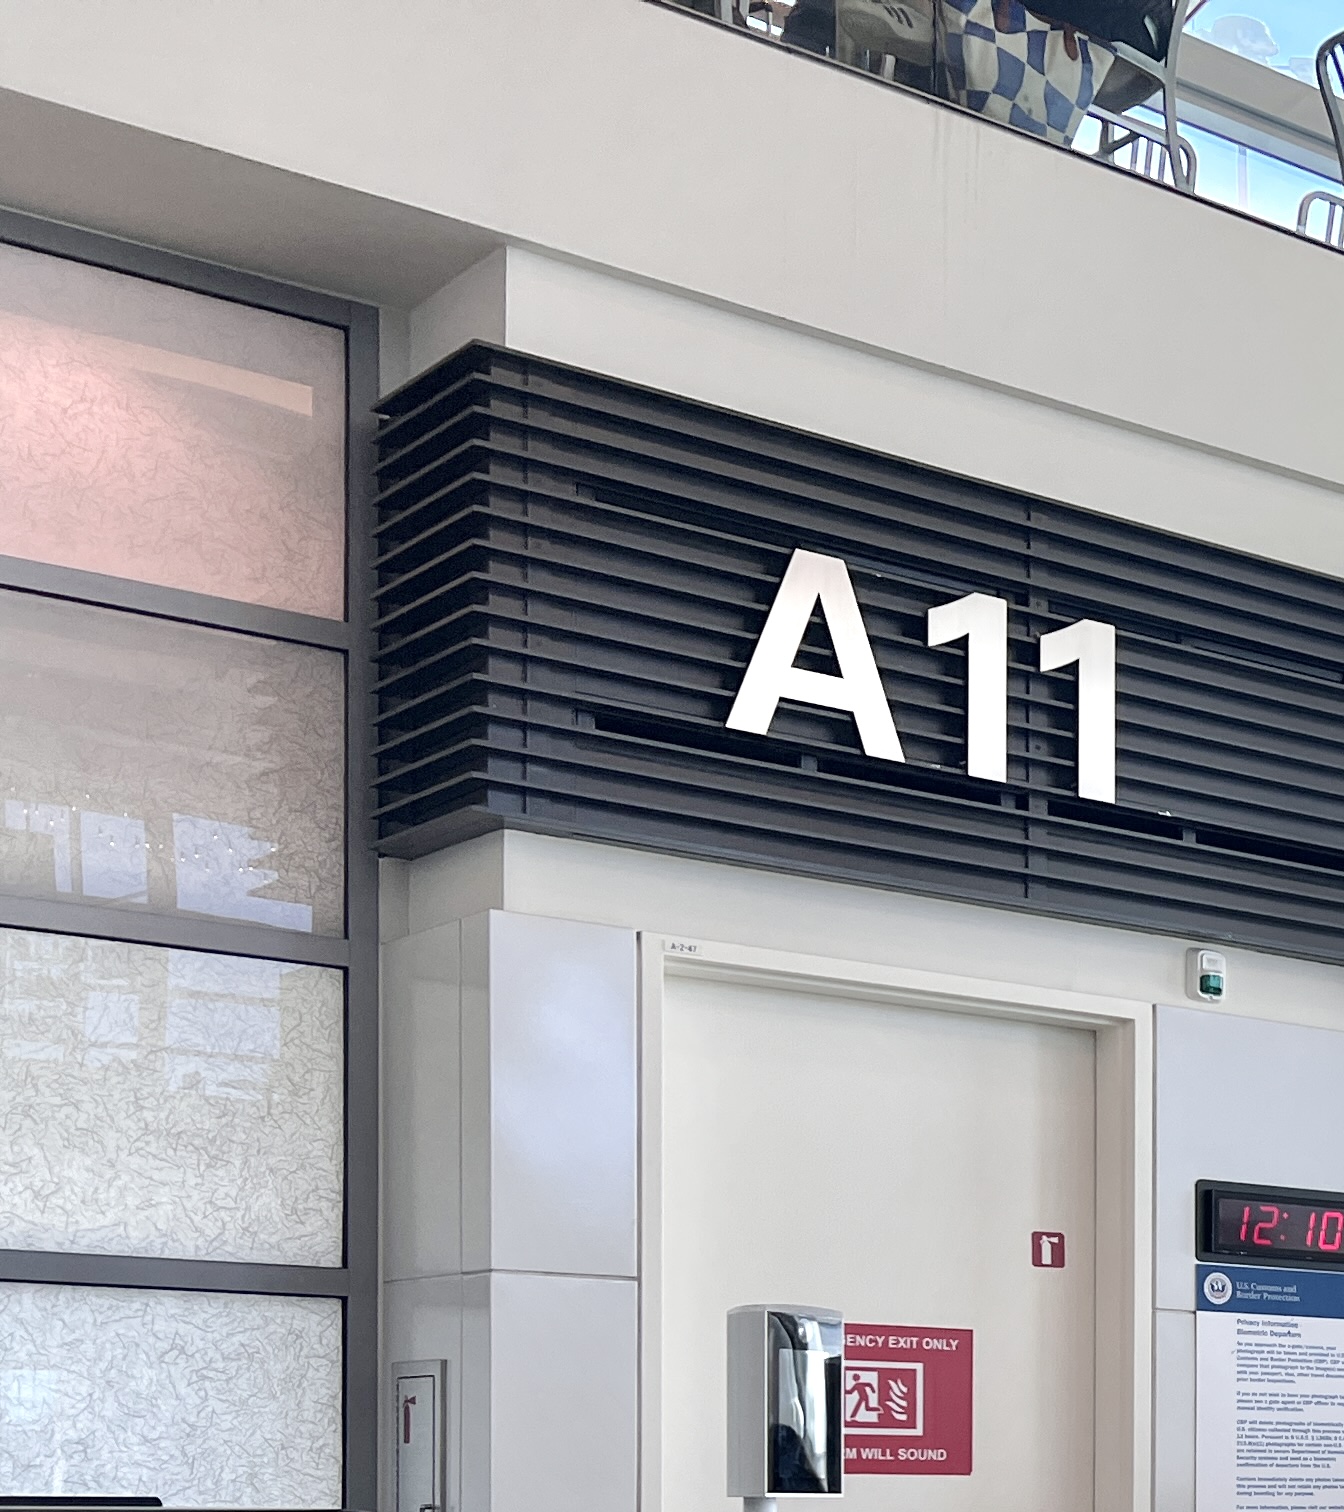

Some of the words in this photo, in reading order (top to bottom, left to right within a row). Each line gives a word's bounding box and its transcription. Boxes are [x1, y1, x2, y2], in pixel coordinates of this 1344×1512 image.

[725, 548, 1116, 804] A11
[1240, 1206, 1344, 1250] 12:10
[888, 1336, 919, 1349] EXIT
[922, 1337, 959, 1350] ONLY
[861, 1448, 894, 1460] WILL
[898, 1448, 947, 1461] SOUND
